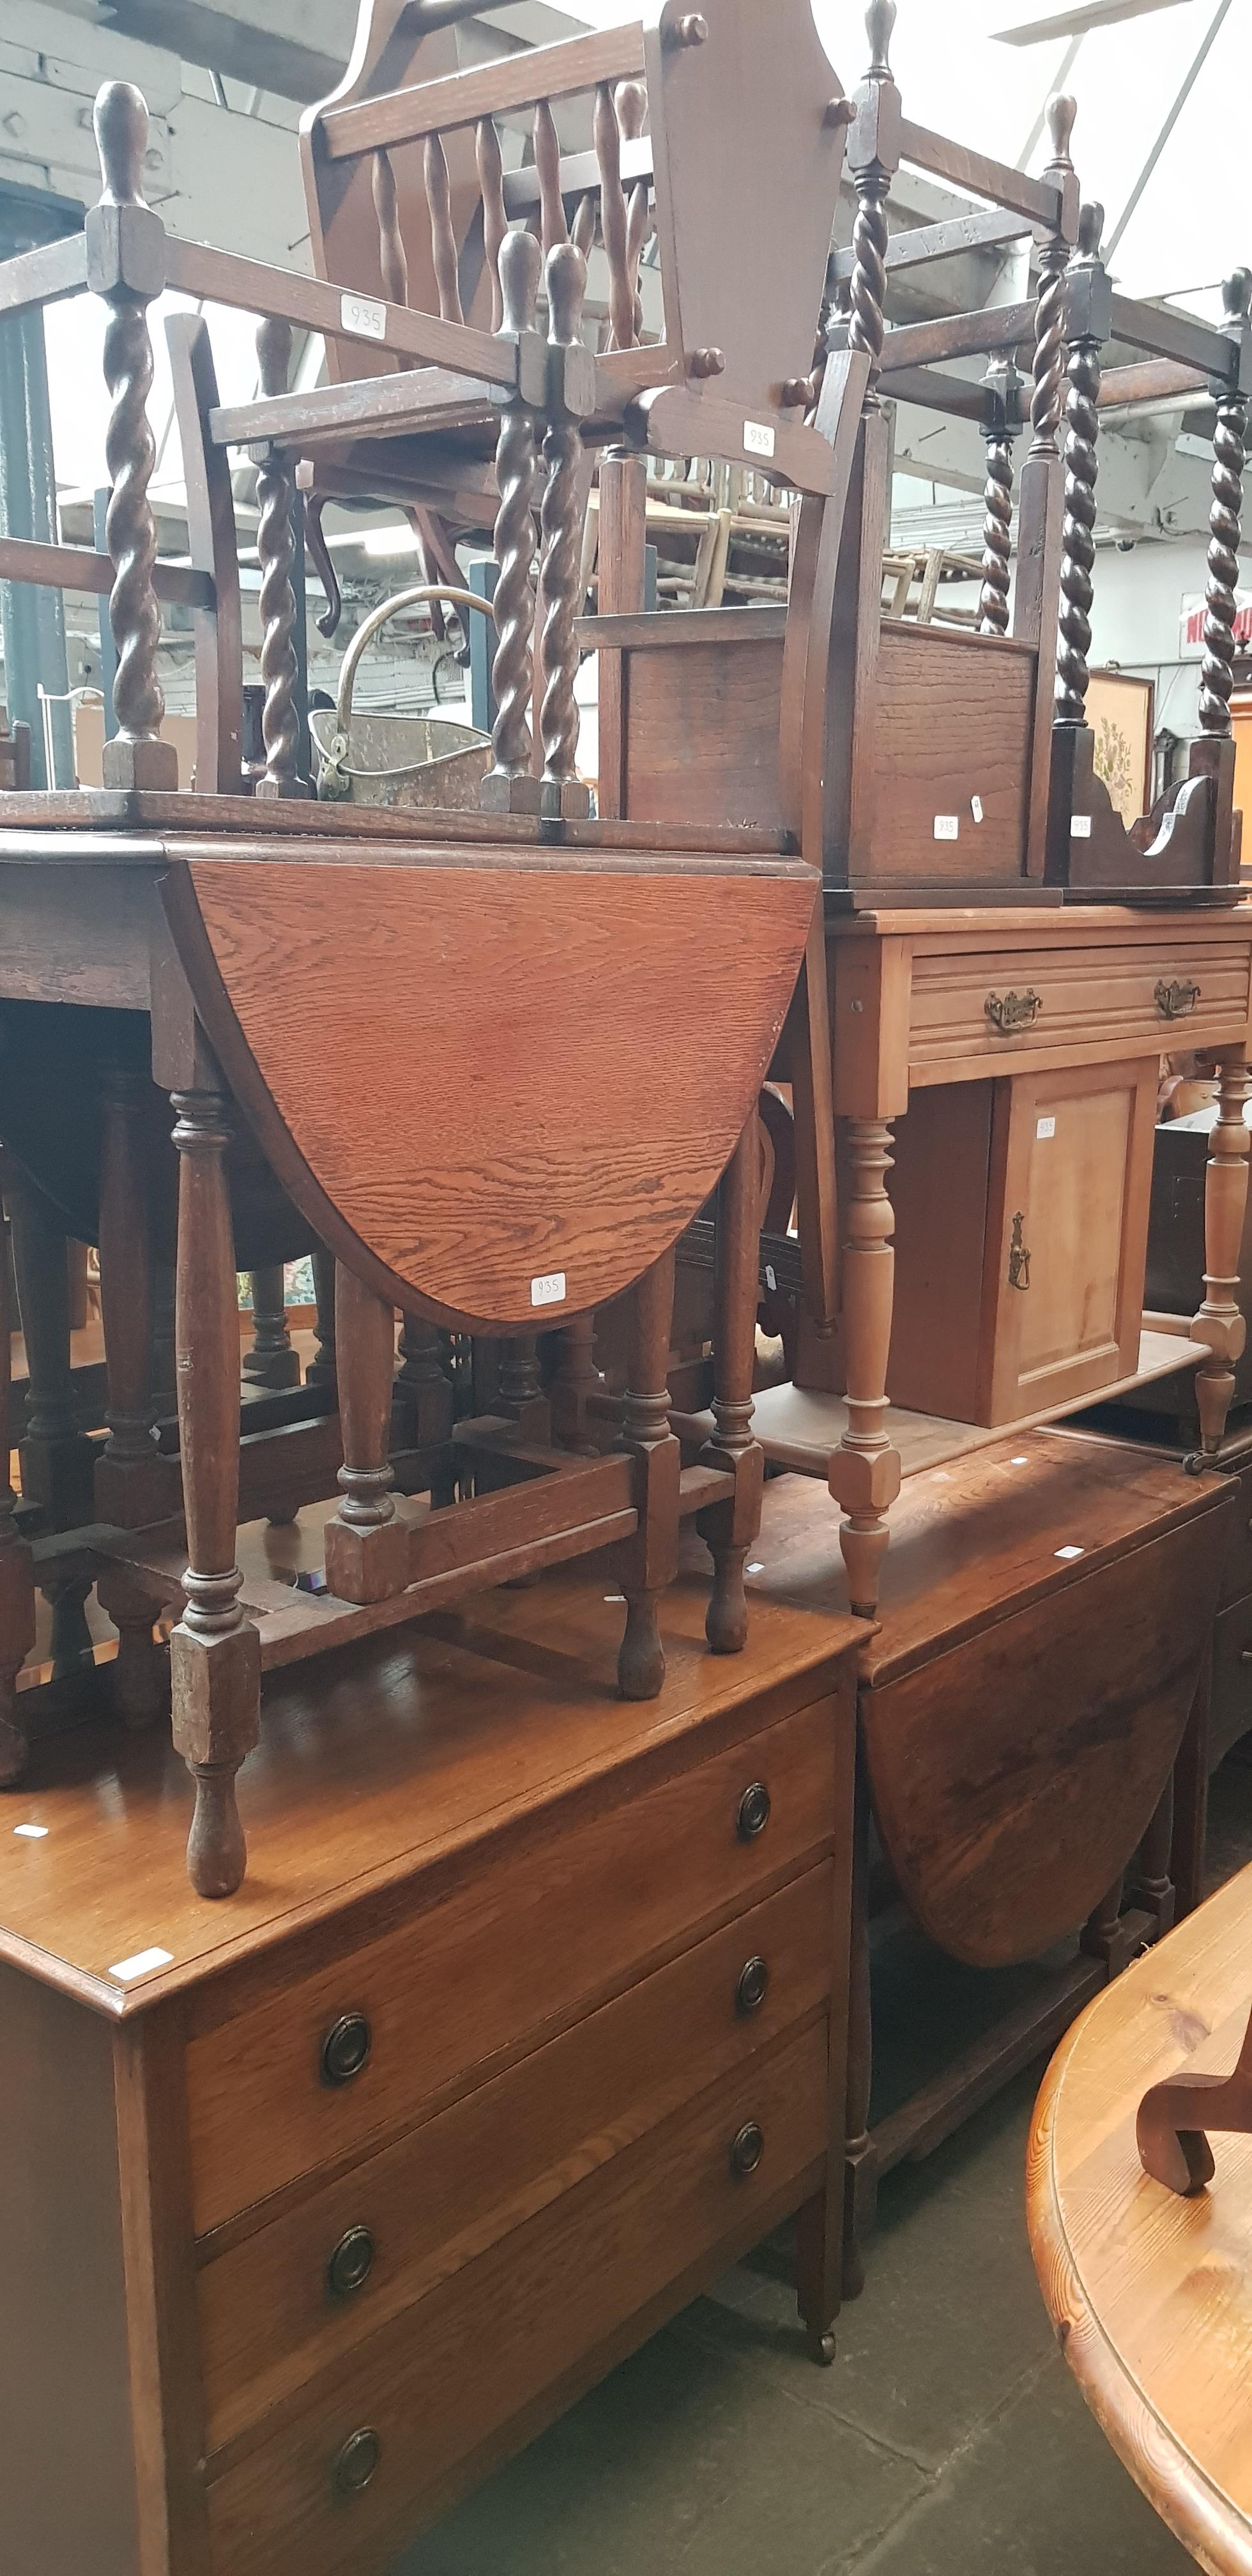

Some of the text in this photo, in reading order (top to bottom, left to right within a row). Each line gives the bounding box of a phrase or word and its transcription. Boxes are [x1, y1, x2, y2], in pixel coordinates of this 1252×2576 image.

[351, 306, 381, 330] 935
[751, 429, 769, 446] 935
[939, 820, 954, 832] 935
[538, 1278, 558, 1296] 935
